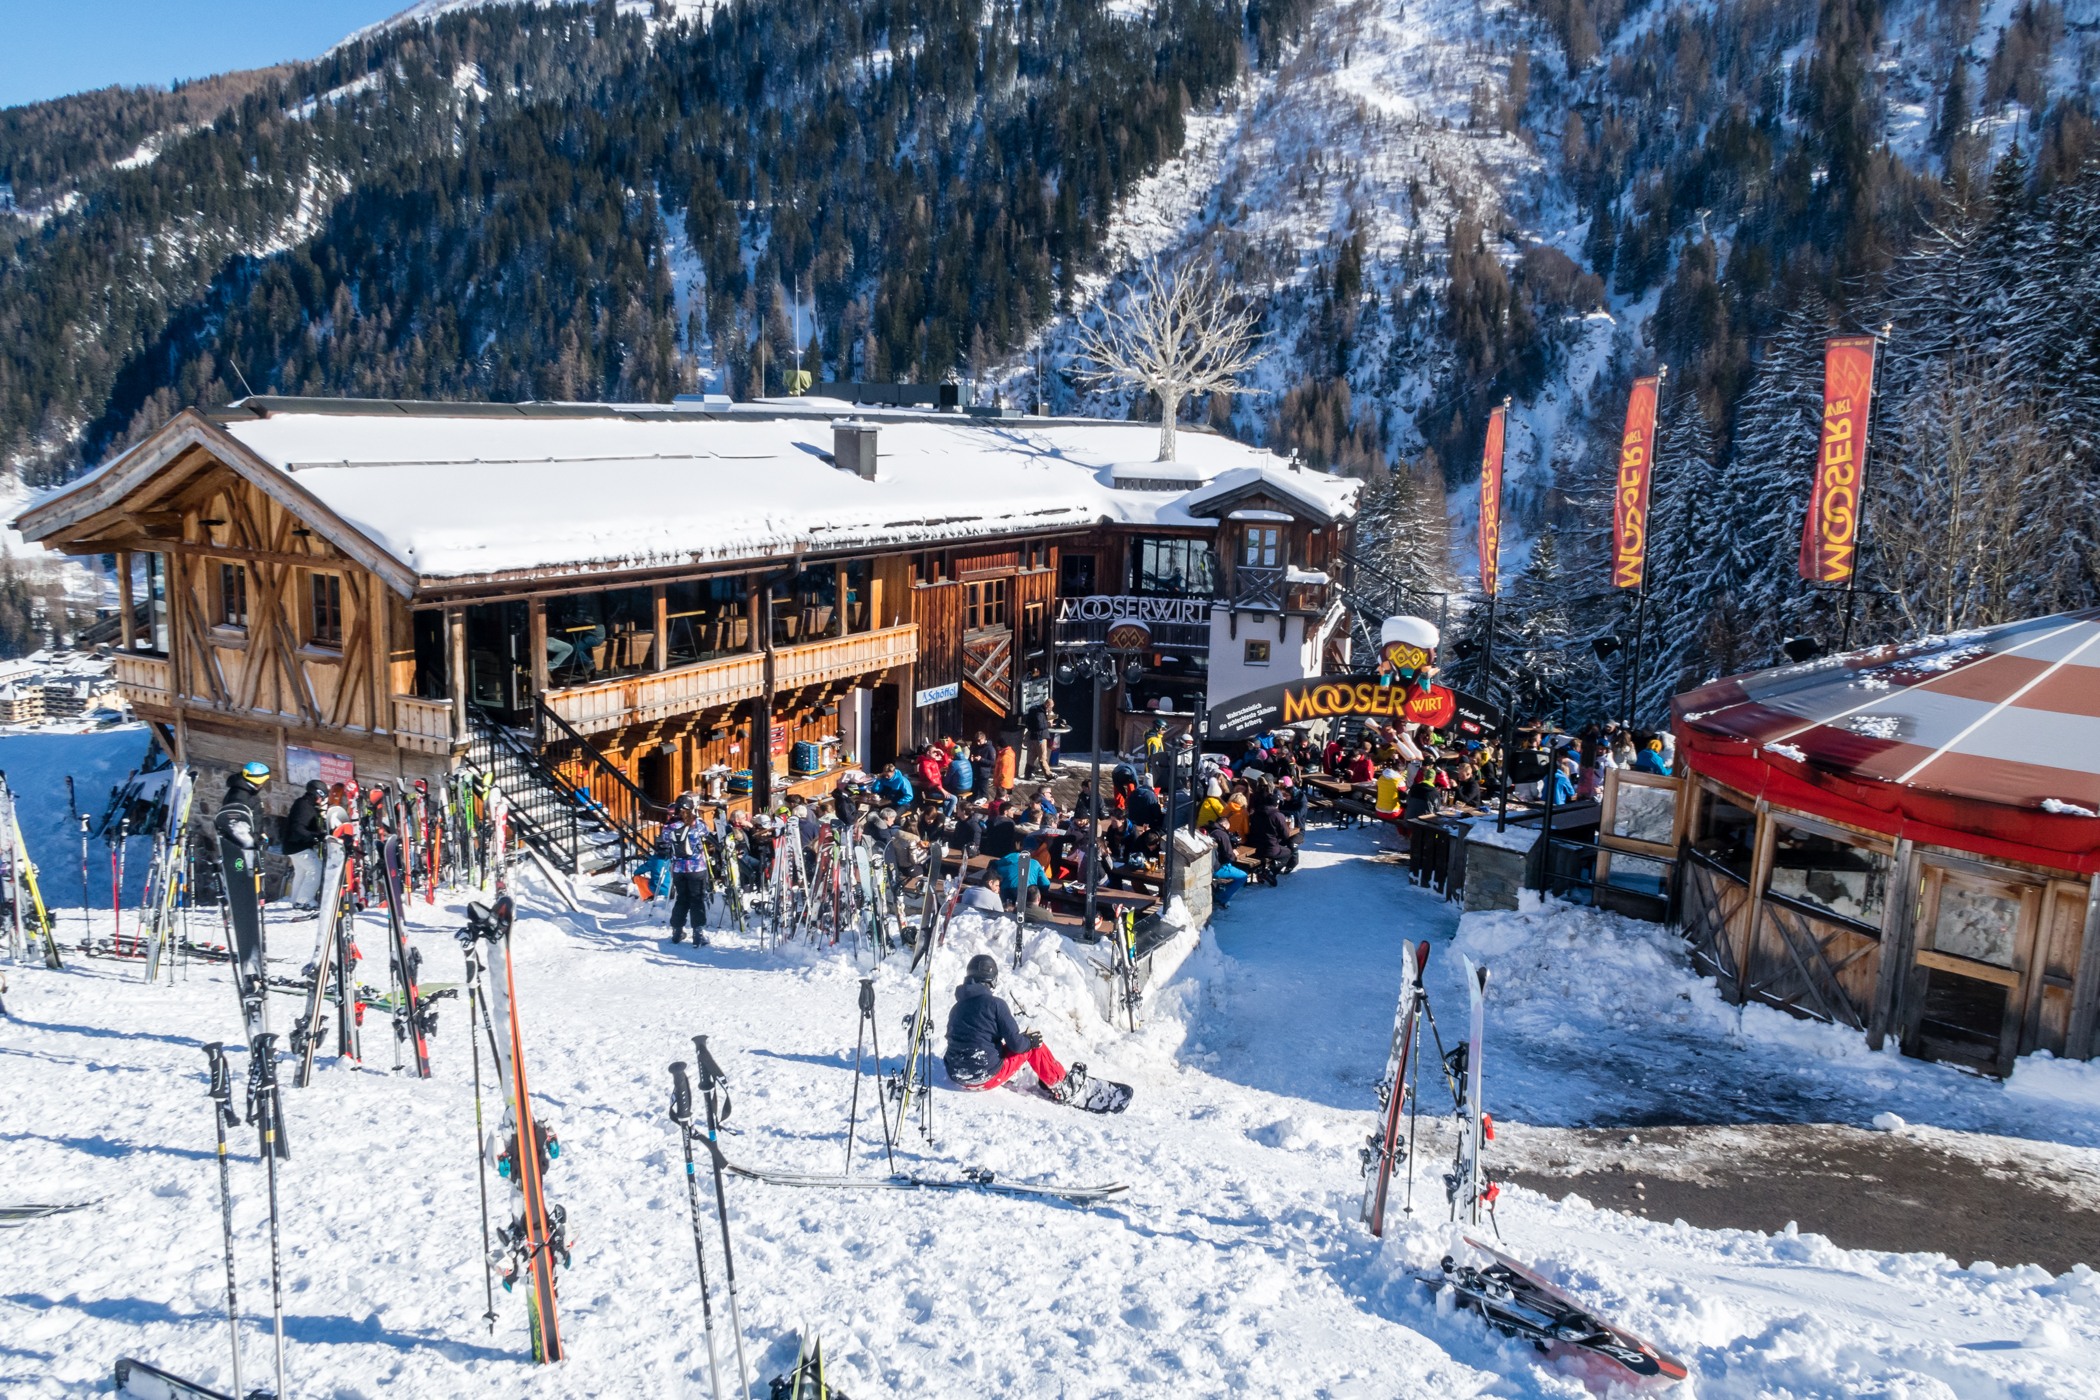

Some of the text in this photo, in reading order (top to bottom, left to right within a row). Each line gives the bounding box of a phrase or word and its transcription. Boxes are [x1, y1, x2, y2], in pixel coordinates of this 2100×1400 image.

[1060, 597, 1208, 623] MOOSERWIRT
[928, 686, 956, 701] Schöffel
[1284, 682, 1407, 722] MOOSER
[1410, 696, 1443, 714] WIRT
[321, 757, 336, 766] SCHAU
[690, 1182, 703, 1242] SCOTT
